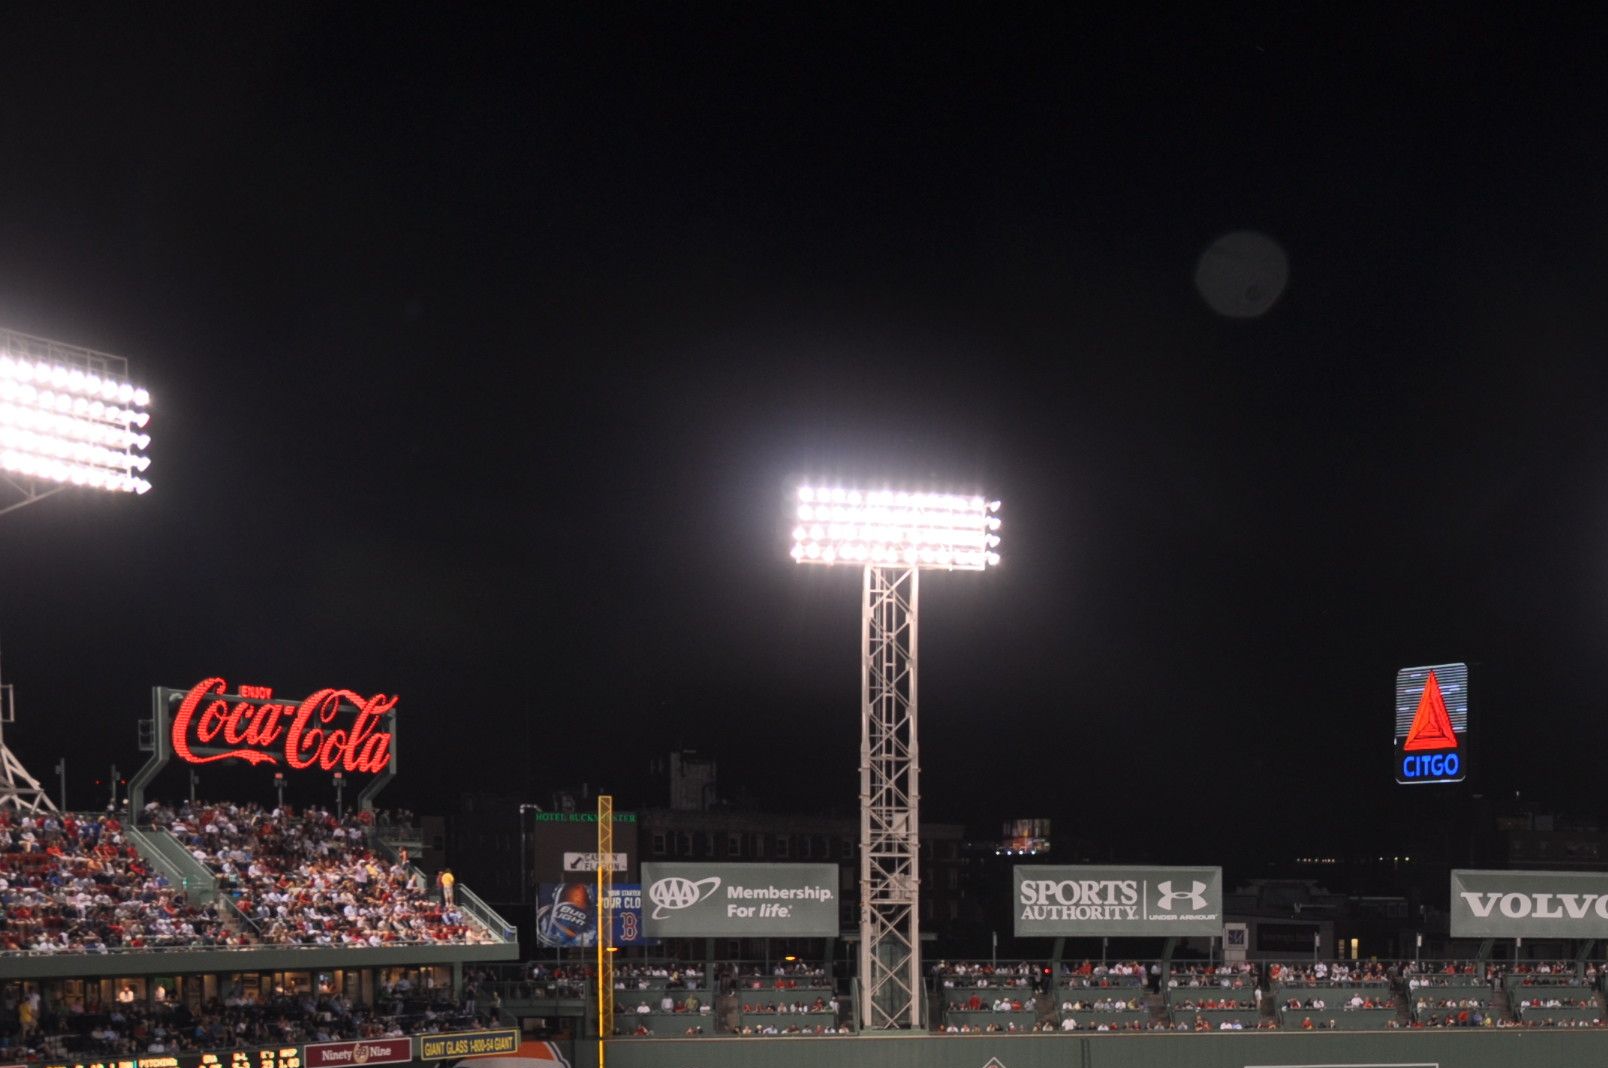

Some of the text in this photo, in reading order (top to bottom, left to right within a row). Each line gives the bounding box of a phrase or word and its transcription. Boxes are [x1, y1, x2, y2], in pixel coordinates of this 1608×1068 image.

[240, 685, 272, 699] ENJOY
[172, 677, 399, 773] Coca-Cola
[1403, 753, 1459, 777] CITGO
[536, 812, 565, 823] HOTEL
[652, 879, 698, 907] AAA
[727, 885, 834, 902] Membership.
[1020, 879, 1139, 905] SPORTS
[556, 912, 586, 926] LIGHT
[560, 905, 588, 920] BUD
[727, 904, 756, 918] For
[322, 1046, 391, 1062] Ninety Nine
[424, 1041, 444, 1057] GIANT
[446, 1039, 468, 1055] GLASS
[494, 1036, 513, 1051] GIANT
